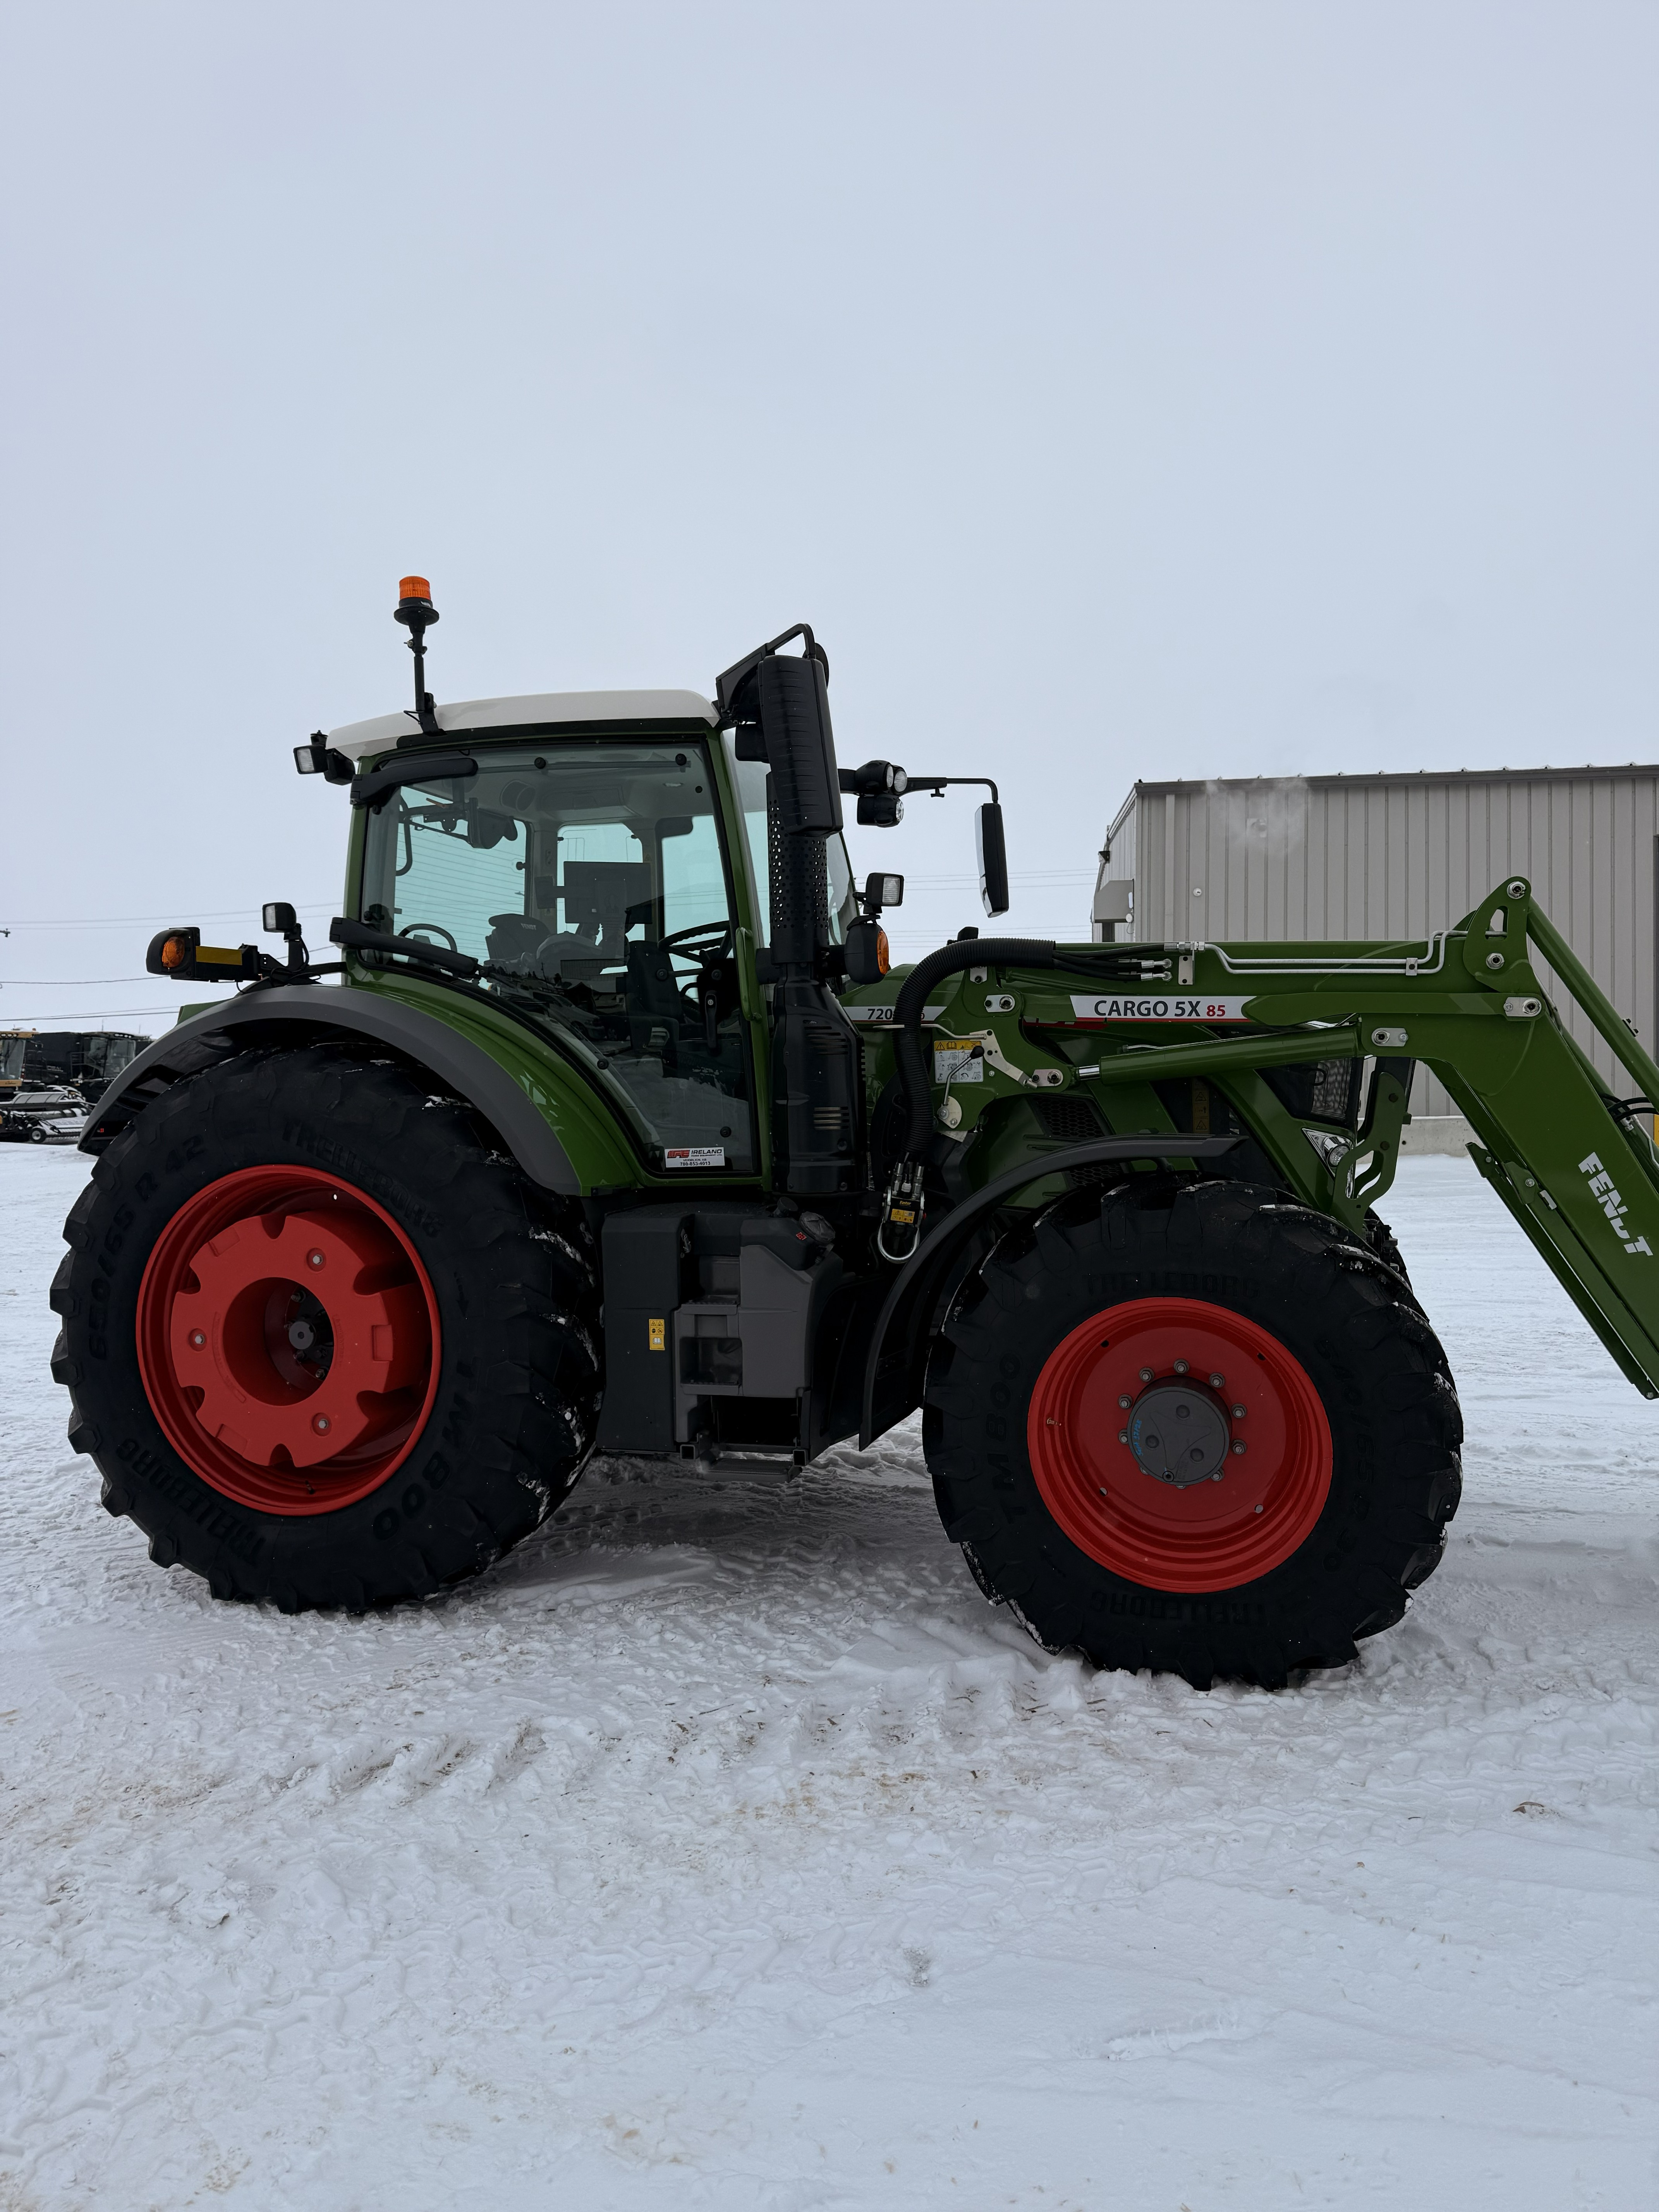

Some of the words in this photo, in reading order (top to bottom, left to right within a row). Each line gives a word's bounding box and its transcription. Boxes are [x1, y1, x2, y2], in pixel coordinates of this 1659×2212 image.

[867, 1008, 893, 1020] 720
[1094, 1000, 1168, 1017] CARGO
[1174, 1001, 1201, 1017] 5X
[1206, 1005, 1226, 1017] 85
[282, 1117, 445, 1238] TRELLEBORG
[1578, 1151, 1654, 1256] FENDT
[89, 1202, 136, 1360] 650/65
[135, 1171, 159, 1202] R
[165, 1135, 206, 1174] 42
[116, 1438, 266, 1566] TRELLEBORG
[1090, 1591, 1268, 1625] TRELLEBORG
